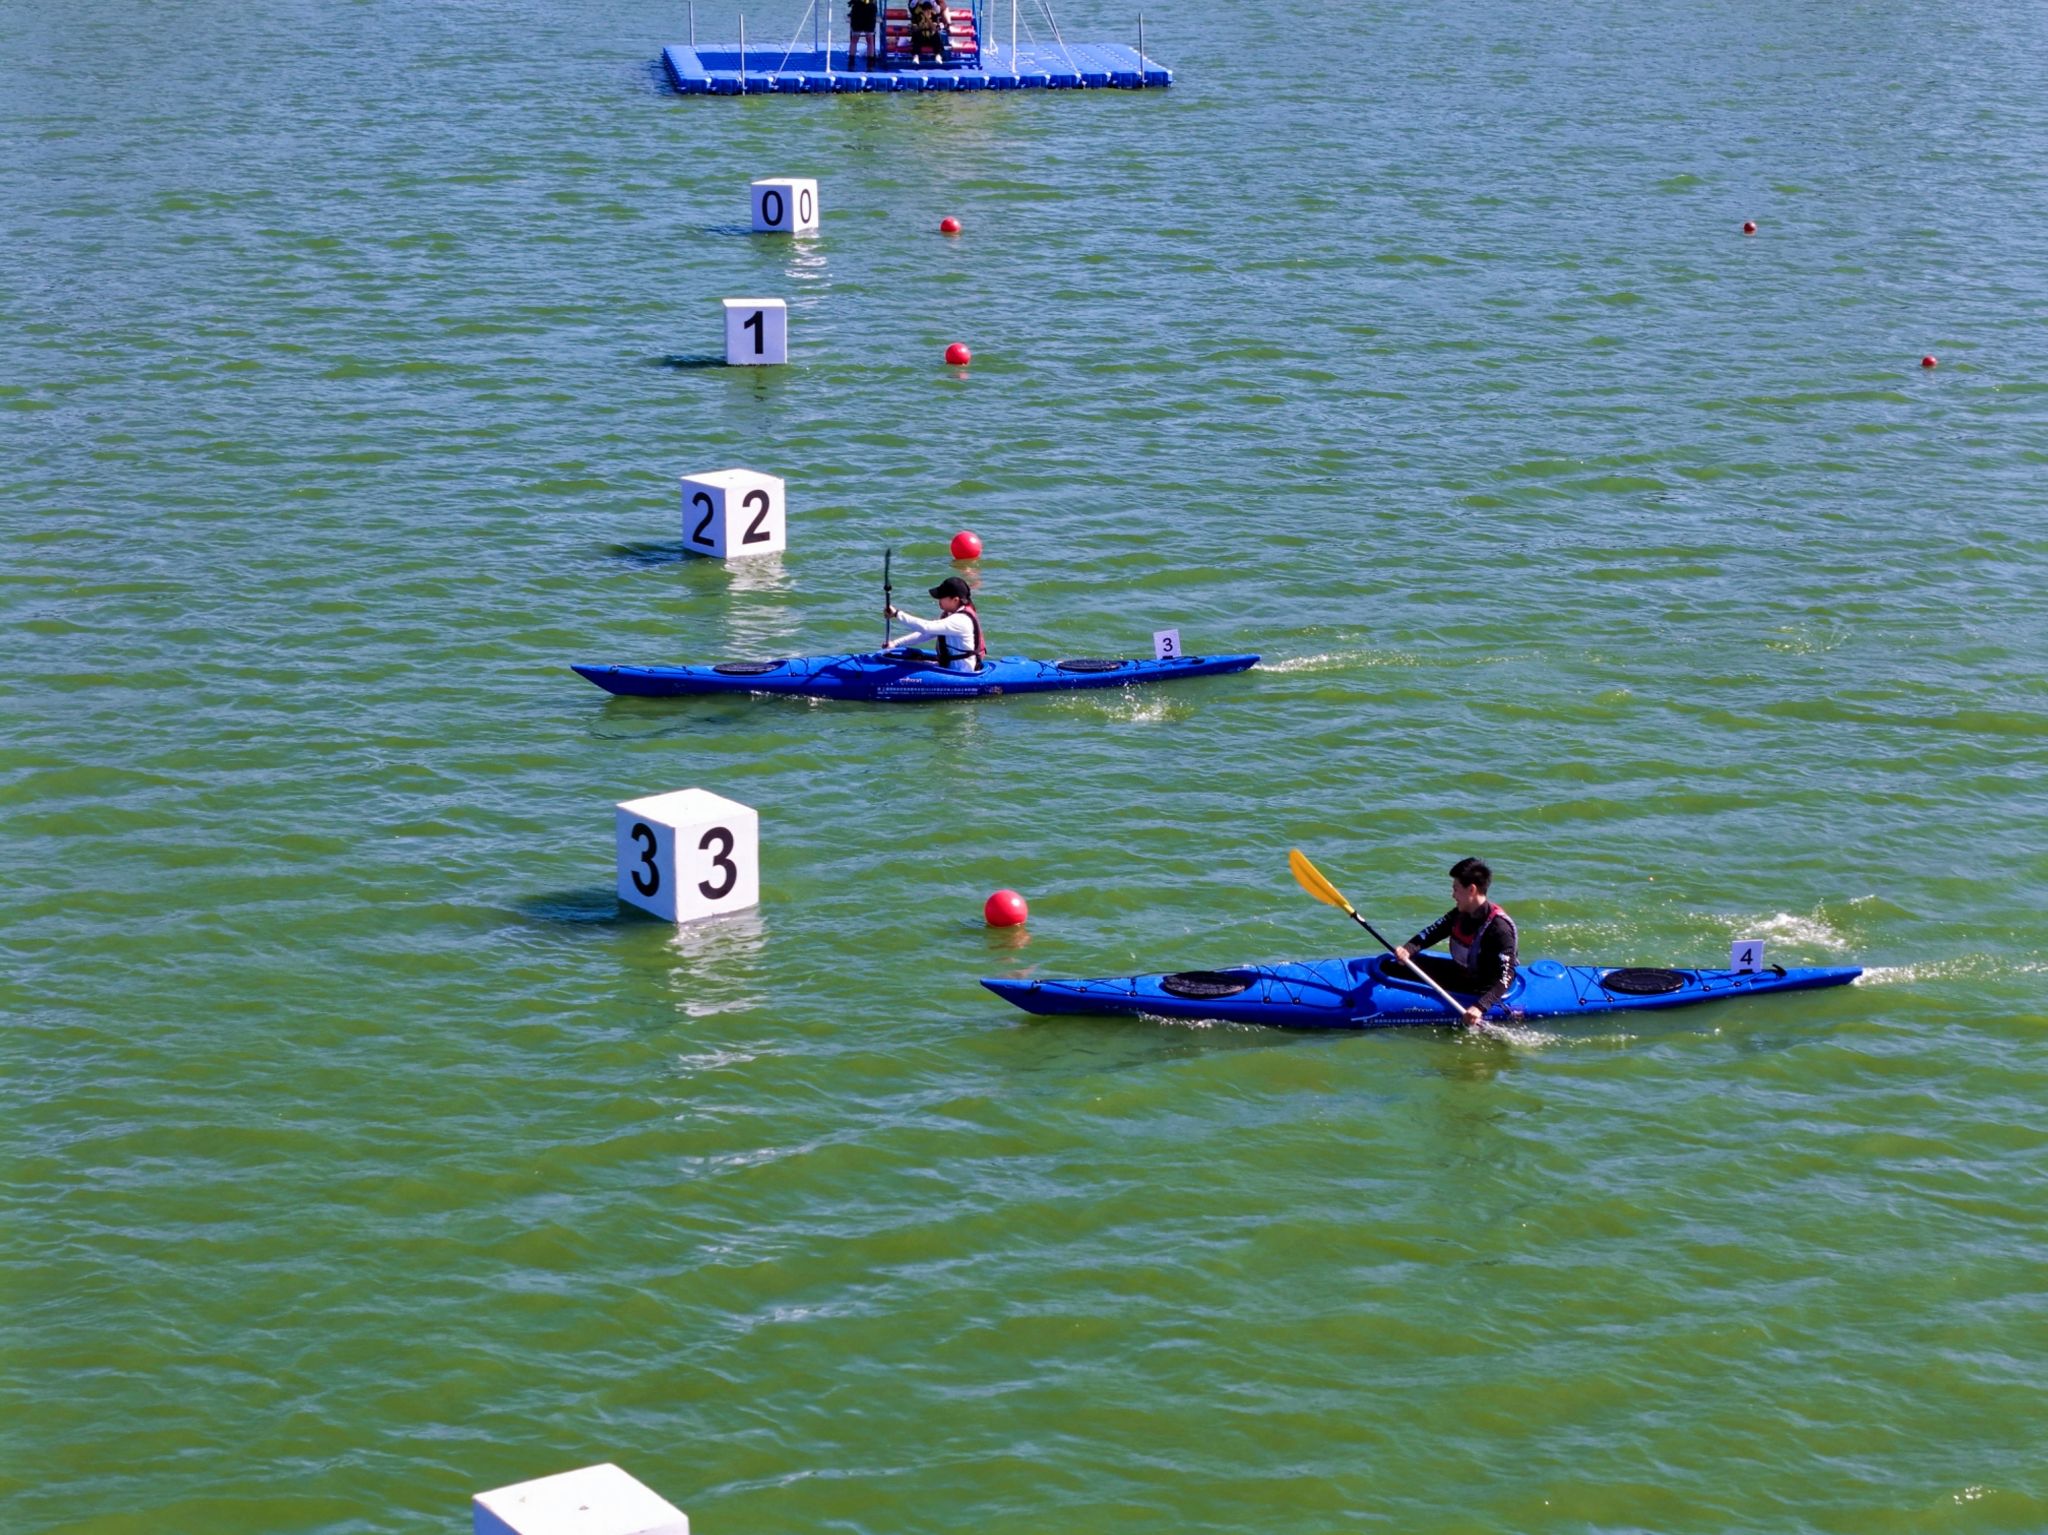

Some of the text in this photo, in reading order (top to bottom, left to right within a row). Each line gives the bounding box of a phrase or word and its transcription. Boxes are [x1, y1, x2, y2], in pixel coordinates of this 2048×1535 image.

[761, 189, 784, 227] 0
[799, 188, 813, 225] 0
[743, 310, 764, 355] 1
[691, 492, 717, 546] 2
[742, 489, 770, 544] 2
[1162, 637, 1174, 652] 3
[629, 823, 660, 897] 3
[698, 826, 738, 900] 3
[1740, 947, 1753, 966] 4
